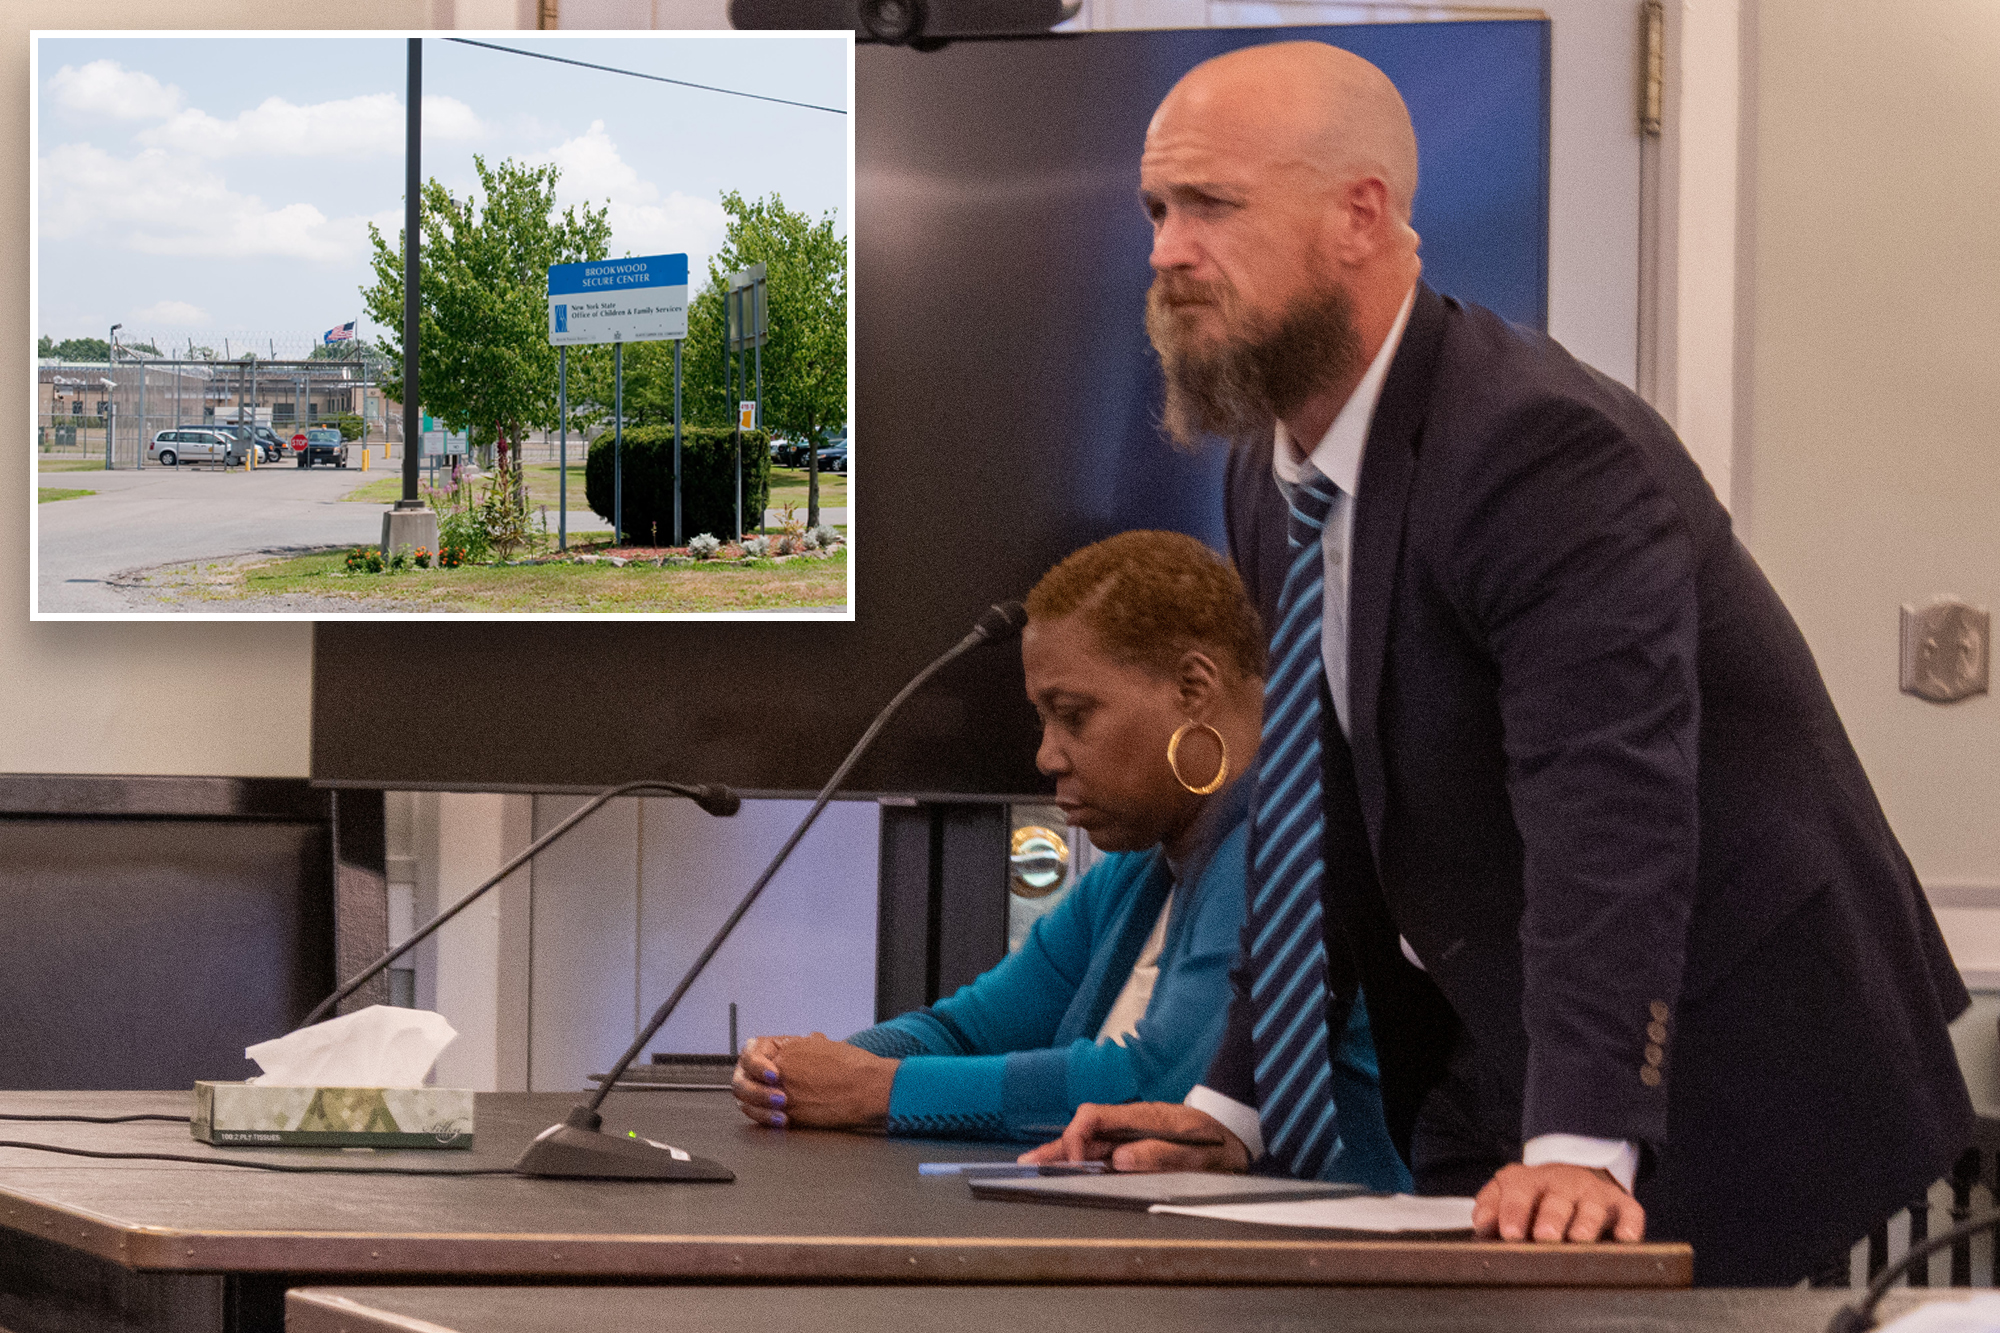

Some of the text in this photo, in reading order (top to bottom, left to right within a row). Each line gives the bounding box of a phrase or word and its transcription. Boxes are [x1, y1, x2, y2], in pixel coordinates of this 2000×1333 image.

[585, 263, 647, 276] BROOKWOOD
[582, 273, 650, 287] SECURE CENTER
[571, 311, 590, 319] Office
[600, 308, 626, 317] Children
[633, 306, 654, 315] Family
[655, 305, 682, 313] Services
[292, 438, 308, 446] STOP
[253, 1133, 281, 1141] TISSUES
